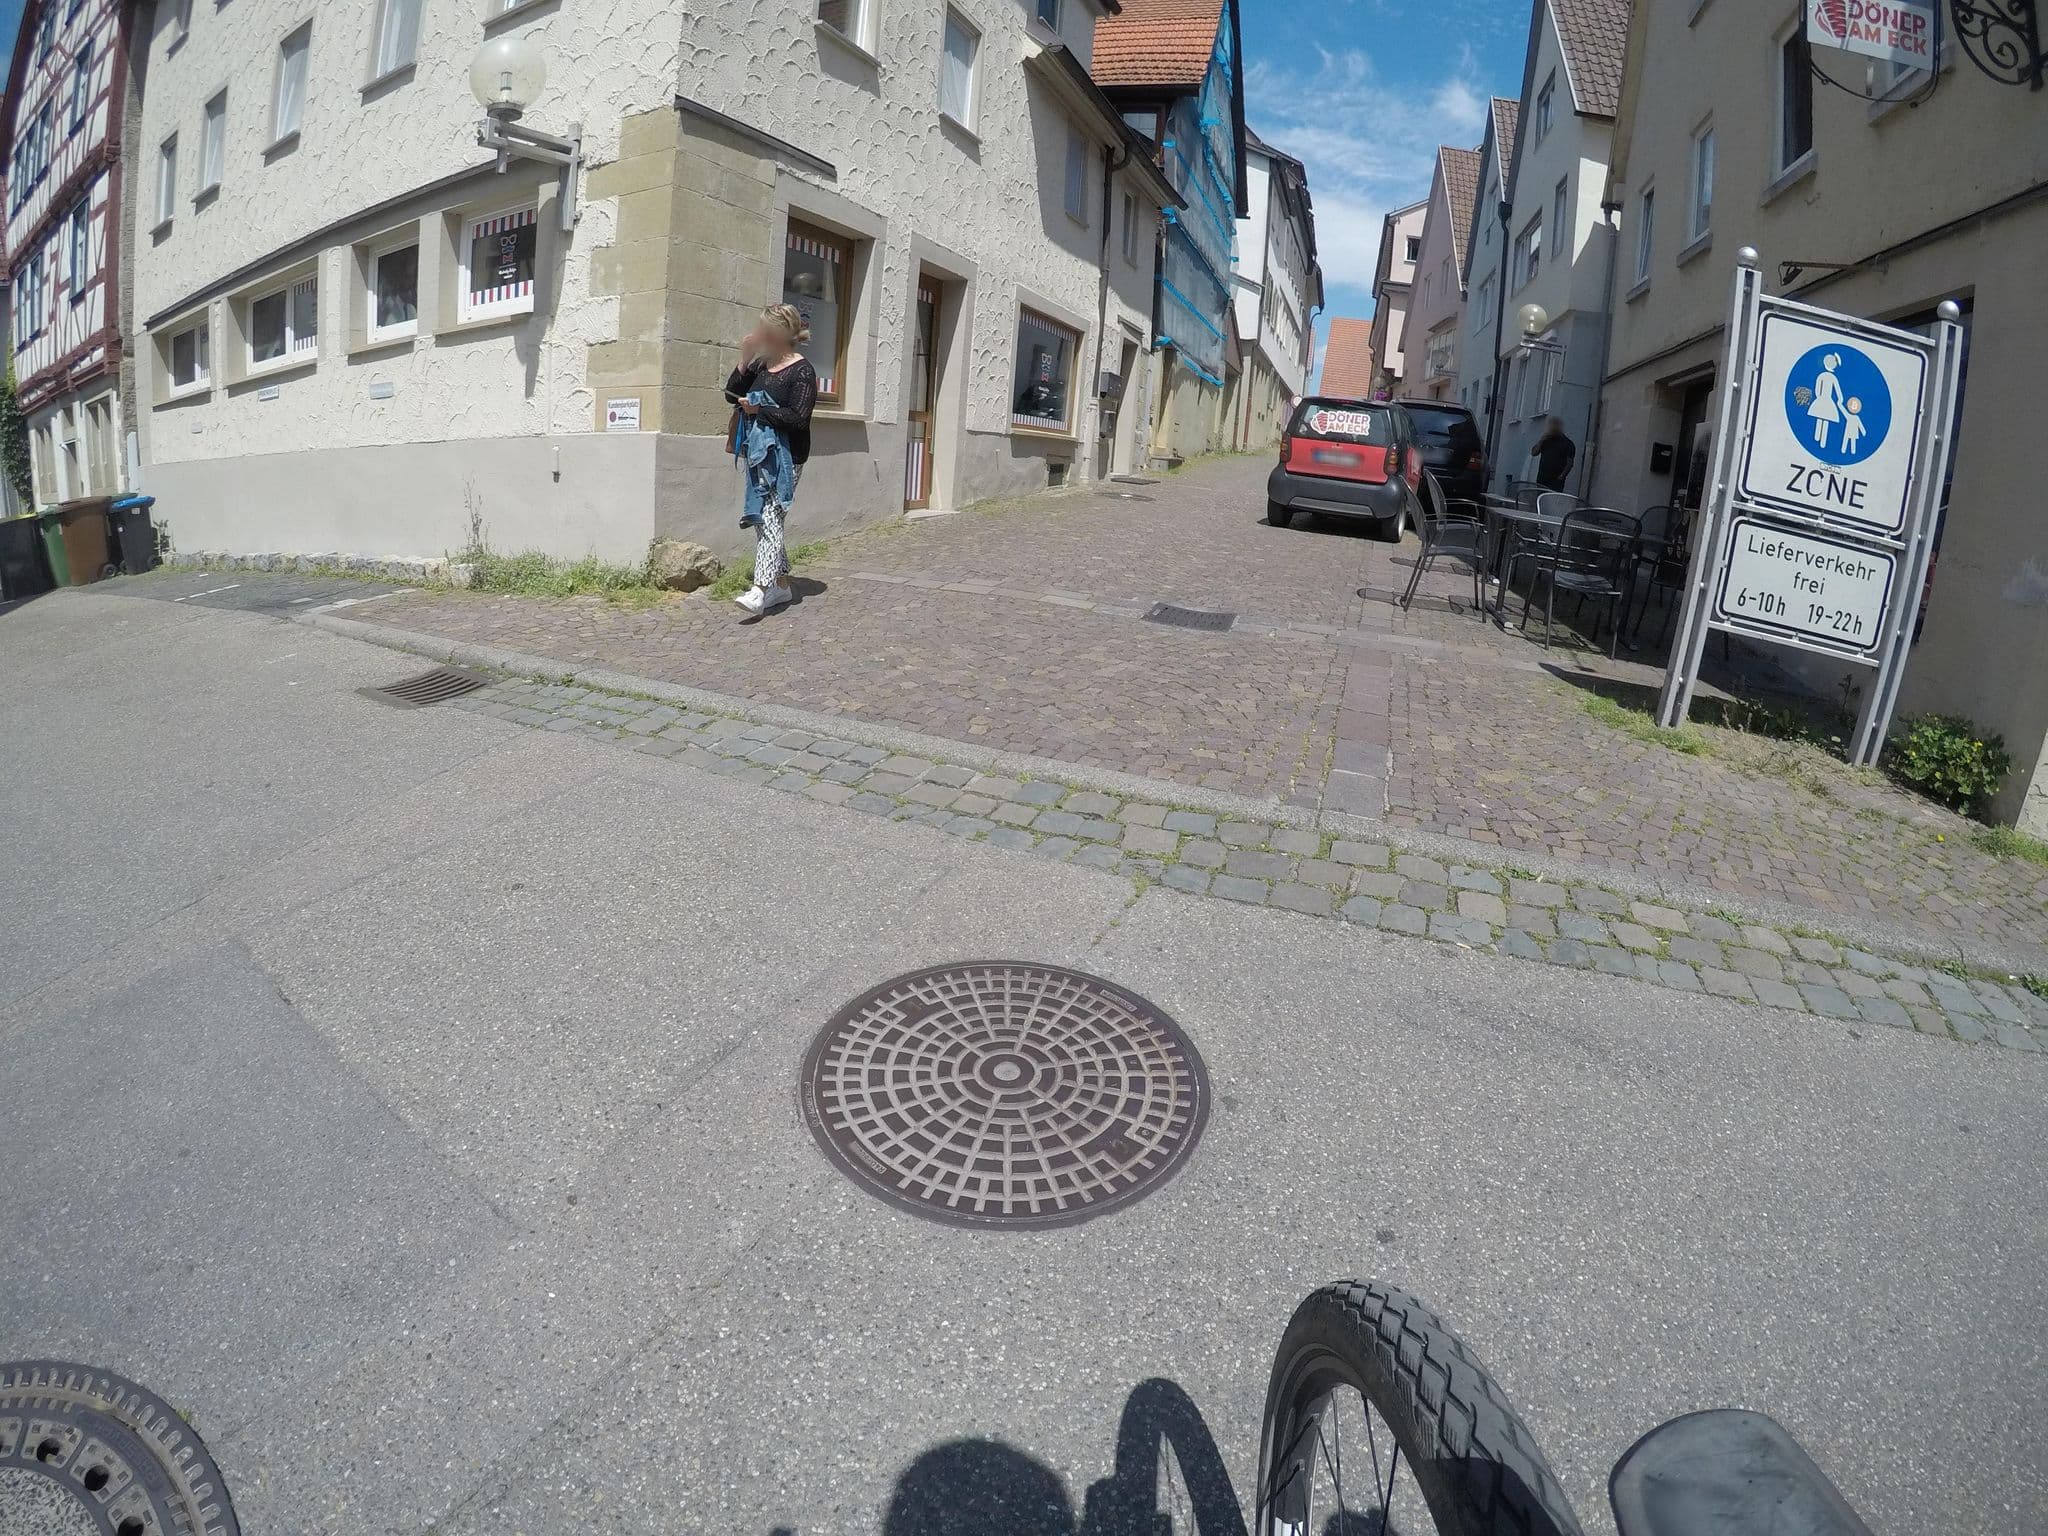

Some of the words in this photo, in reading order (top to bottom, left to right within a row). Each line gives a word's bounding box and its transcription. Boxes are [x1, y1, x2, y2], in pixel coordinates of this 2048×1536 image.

[1850, 21, 1881, 45] AM
[1887, 30, 1927, 56] ECK
[1328, 423, 1345, 432] AM
[1347, 424, 1368, 434] ECK
[1747, 534, 1876, 582] Lieferverkehr
[1793, 571, 1826, 596] frei
